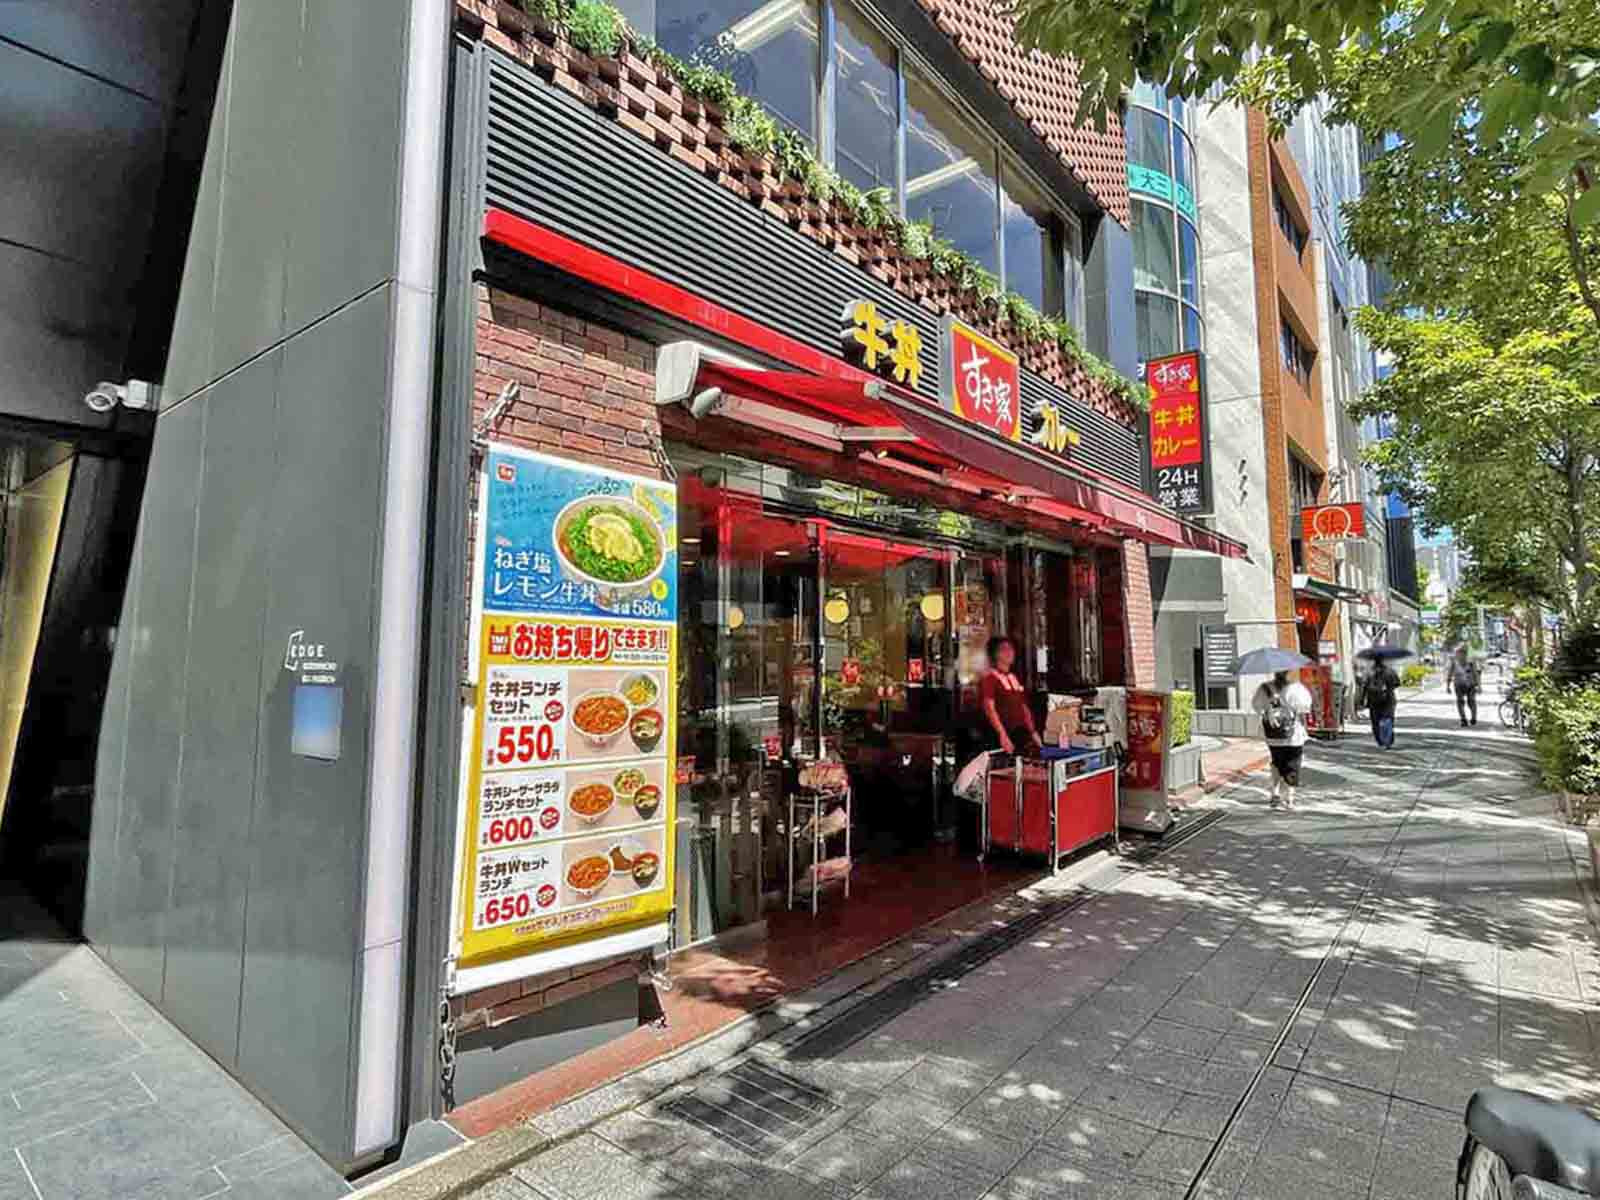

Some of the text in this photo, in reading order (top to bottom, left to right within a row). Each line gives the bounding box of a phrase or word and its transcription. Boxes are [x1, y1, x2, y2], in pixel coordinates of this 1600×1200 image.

[846, 299, 1081, 453] 牛丼 すき家 カレー
[1155, 404, 1195, 430] 牛丼
[1153, 436, 1198, 458] カレー
[1158, 468, 1198, 489] 24H
[1160, 487, 1199, 508] 営業
[494, 548, 552, 574] ねぎ塩
[494, 571, 597, 604] レモン牛丼
[291, 644, 325, 657] EDGE
[514, 623, 609, 658] お持ち帰り
[489, 681, 561, 697] 牛丼ランチ
[489, 699, 530, 714] セット
[484, 796, 544, 813] ランチセット
[480, 857, 549, 878] 牛丼Wセット
[480, 876, 512, 893] ランチ
